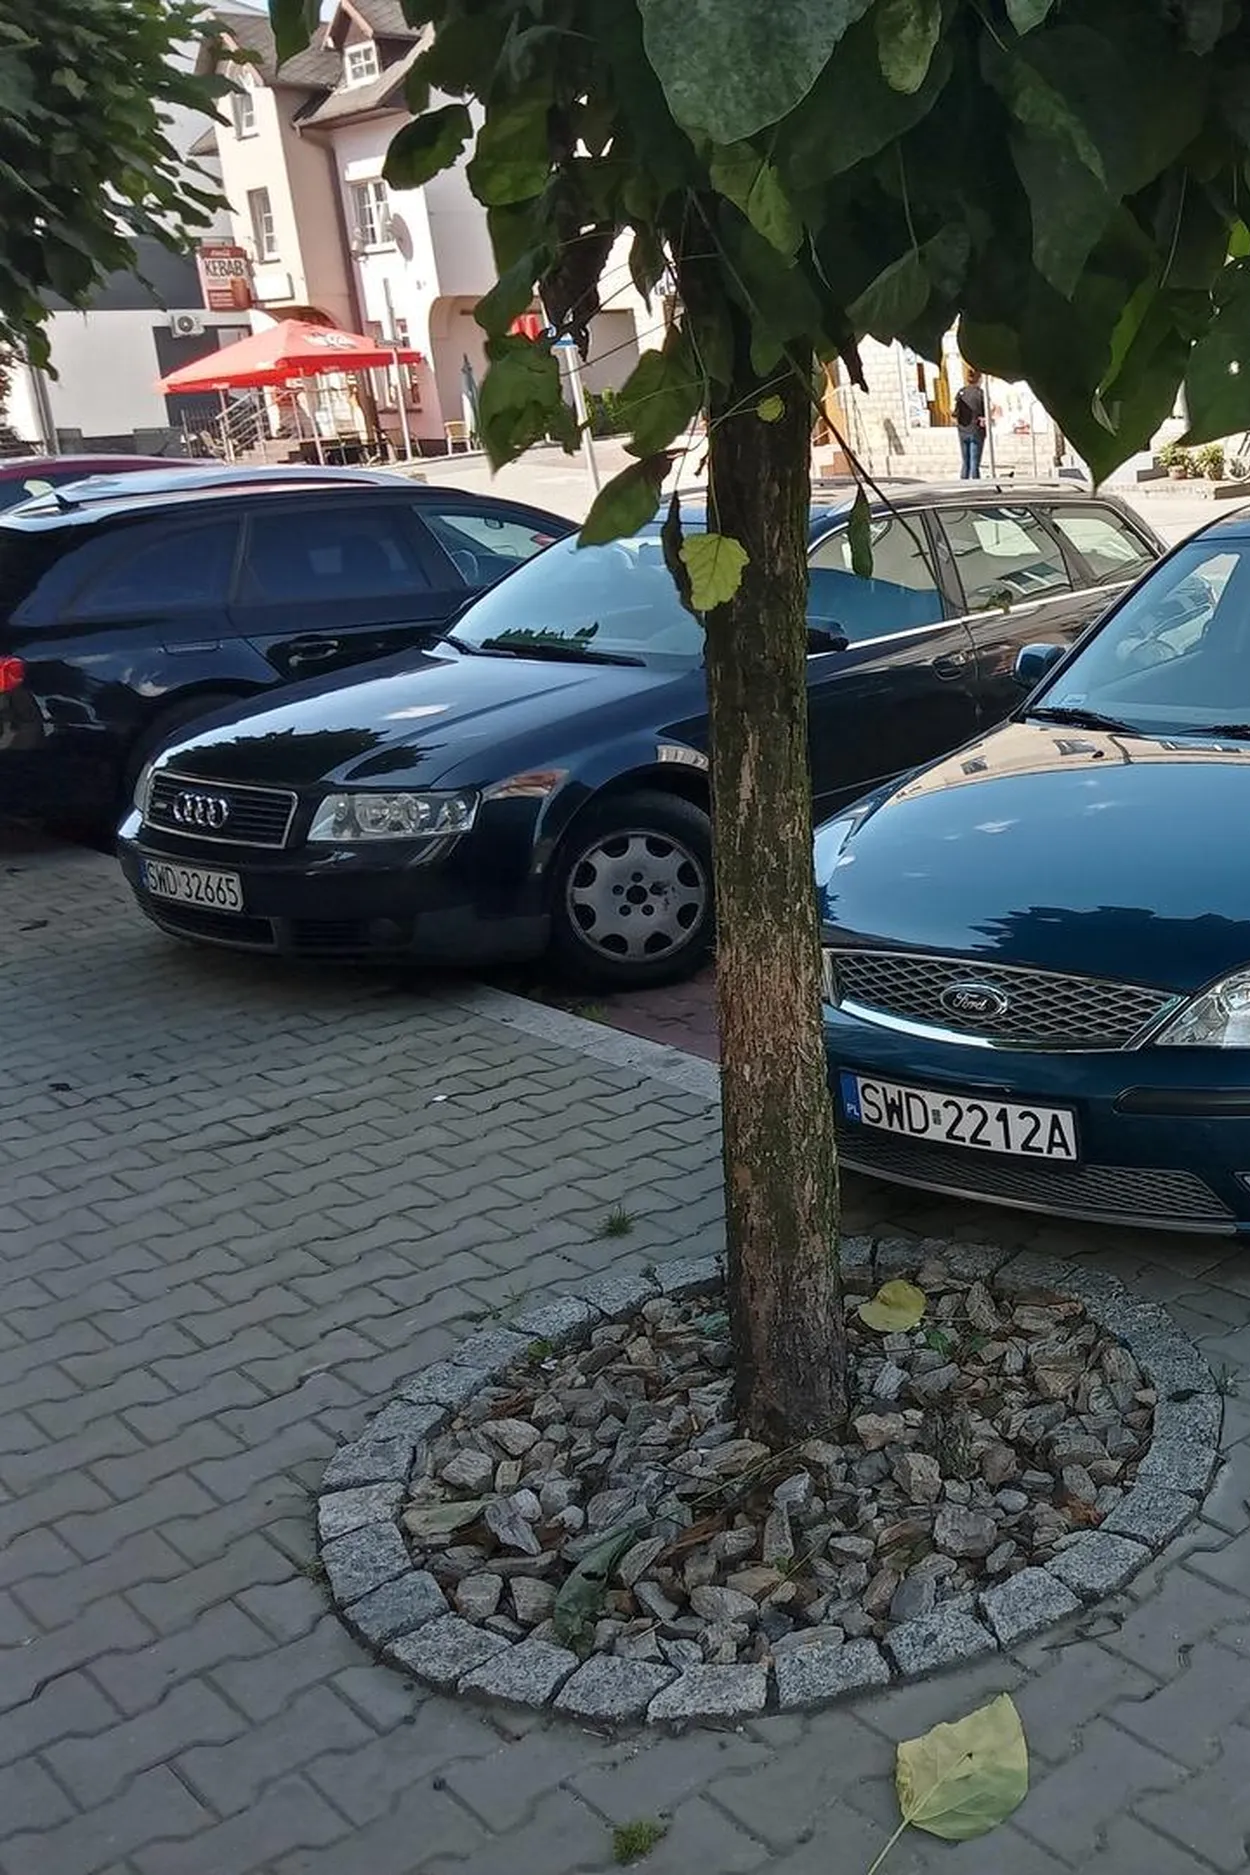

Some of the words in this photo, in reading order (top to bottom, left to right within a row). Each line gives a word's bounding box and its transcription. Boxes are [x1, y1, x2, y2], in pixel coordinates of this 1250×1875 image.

[205, 260, 244, 277] KEBAB
[147, 862, 178, 895] SWD
[181, 870, 239, 907] 32665
[952, 992, 988, 1010] Ford
[846, 1103, 859, 1116] PL
[860, 1083, 930, 1134] SWD
[943, 1100, 1072, 1157] 2212A
